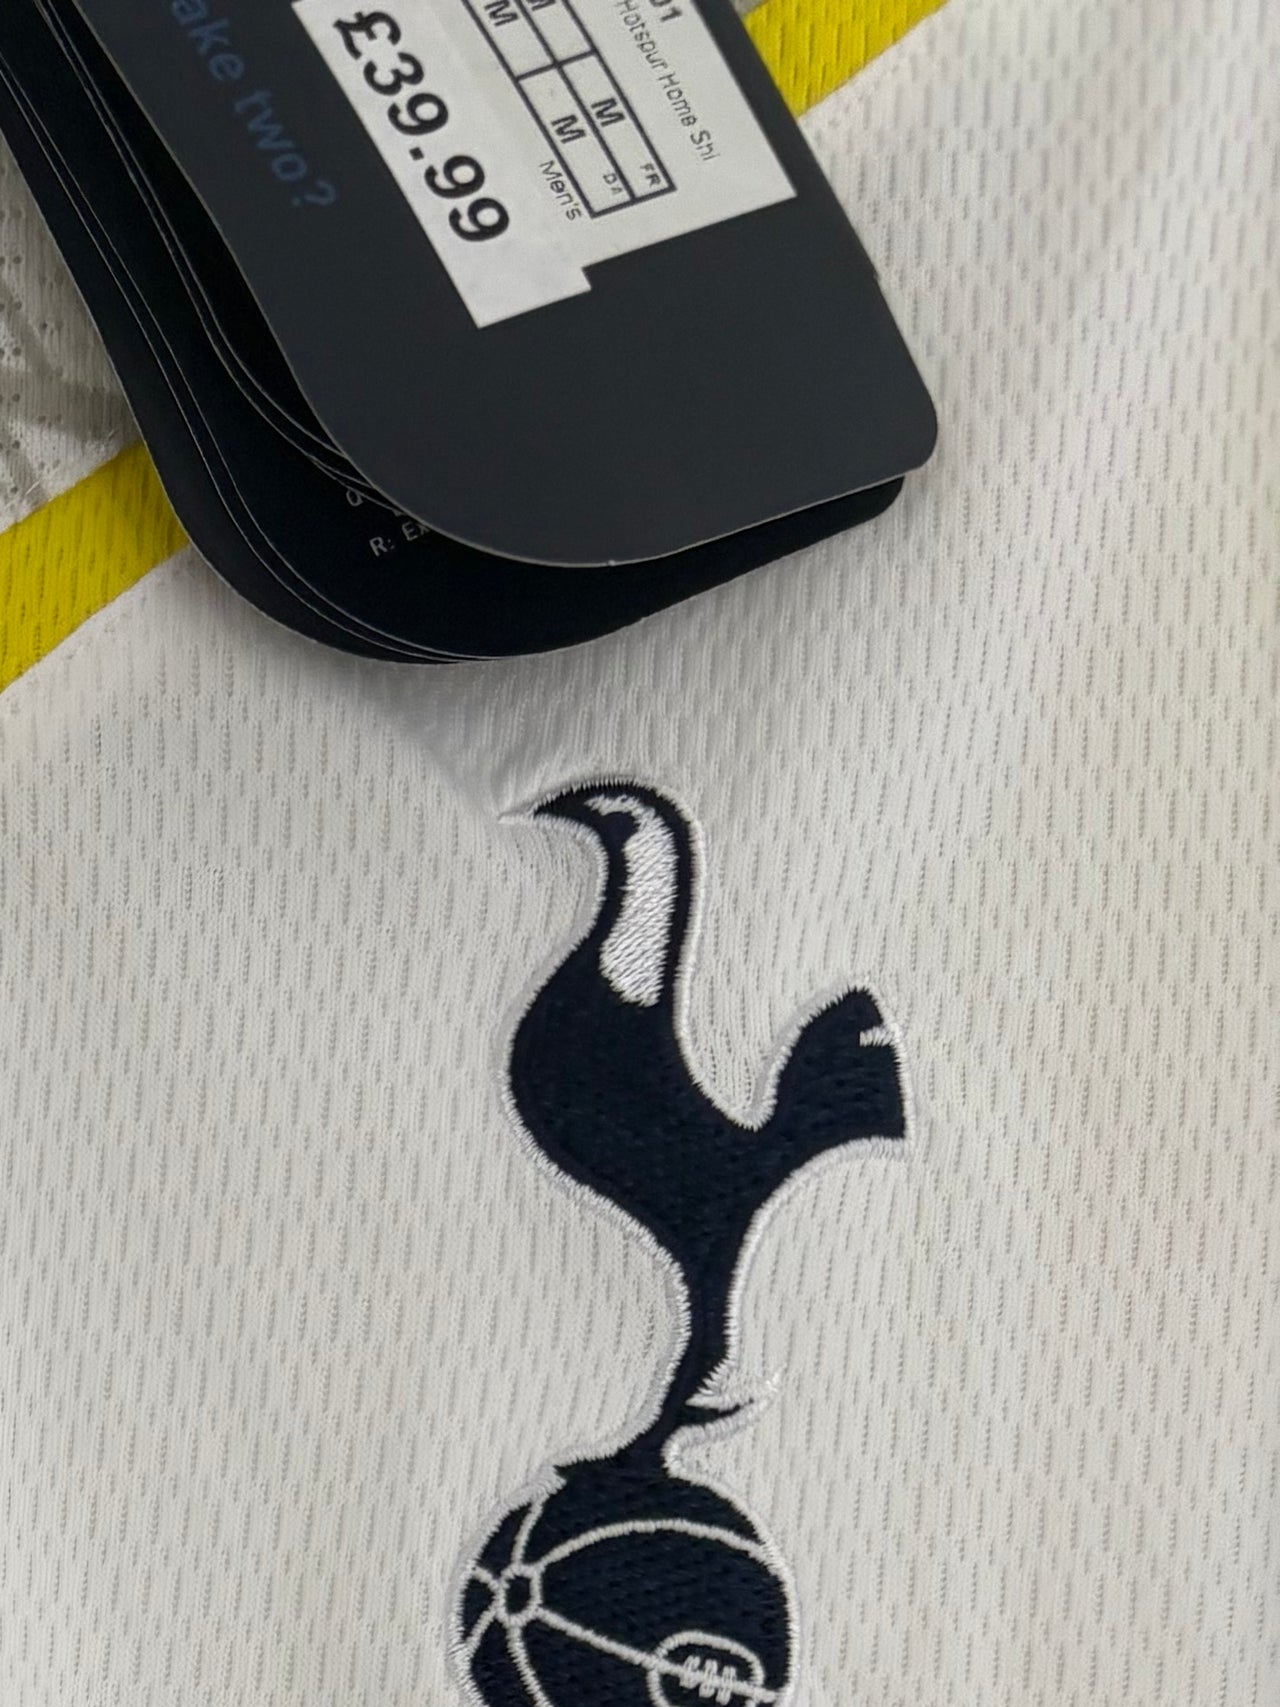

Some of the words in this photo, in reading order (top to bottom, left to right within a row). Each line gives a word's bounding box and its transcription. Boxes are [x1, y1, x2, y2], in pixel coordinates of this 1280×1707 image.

[235, 89, 337, 207] two?
[333, 11, 510, 243] £39.99
[550, 114, 587, 144] M
[590, 97, 625, 128] M
[657, 71, 698, 127] Home
[689, 130, 721, 162] Shi
[539, 160, 583, 221] Men's
